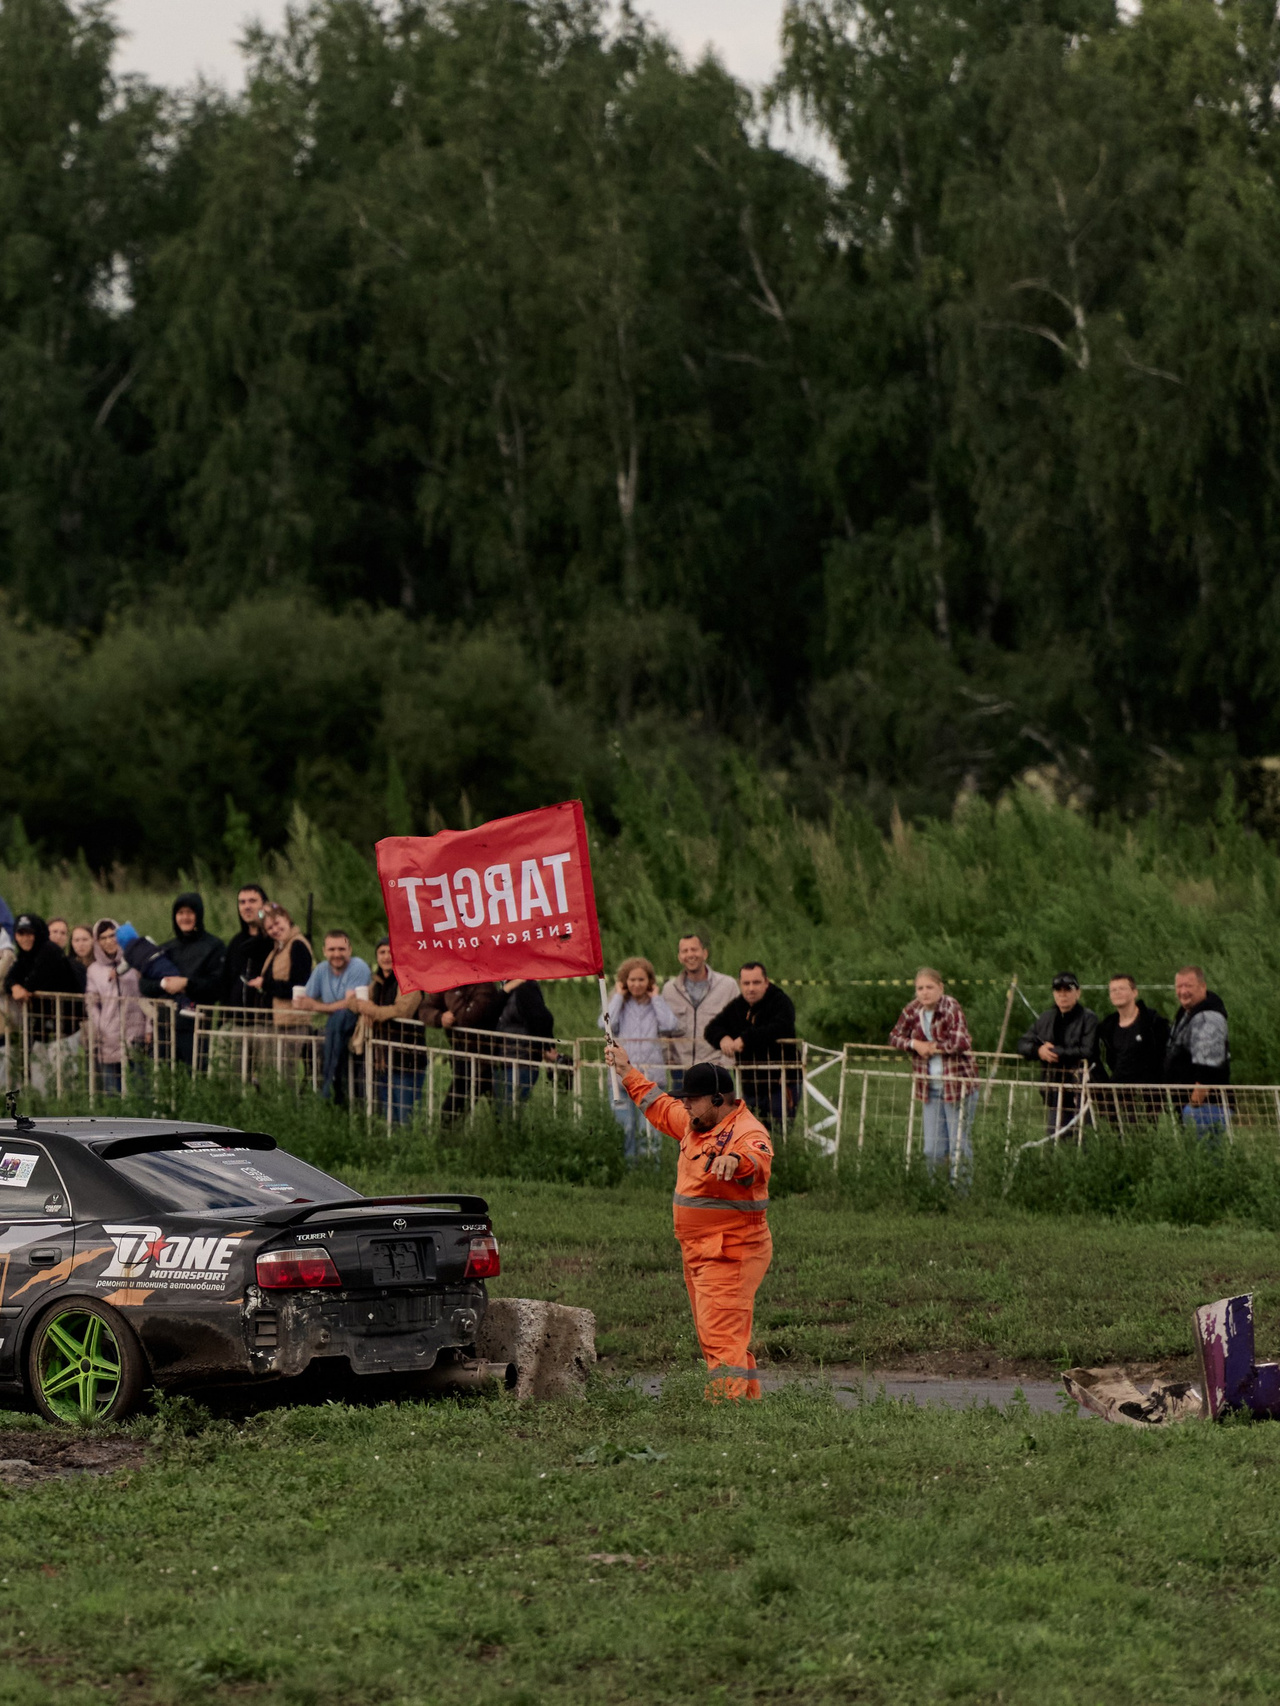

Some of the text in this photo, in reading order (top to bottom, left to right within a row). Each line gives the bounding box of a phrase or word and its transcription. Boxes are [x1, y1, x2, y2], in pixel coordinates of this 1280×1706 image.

[296, 1232, 326, 1242] TOURER
[149, 1270, 229, 1281] MOTORSPORT
[96, 1279, 128, 1288] ремонт
[135, 1281, 168, 1289] тюнинг
[169, 1281, 226, 1291] автомобилей
